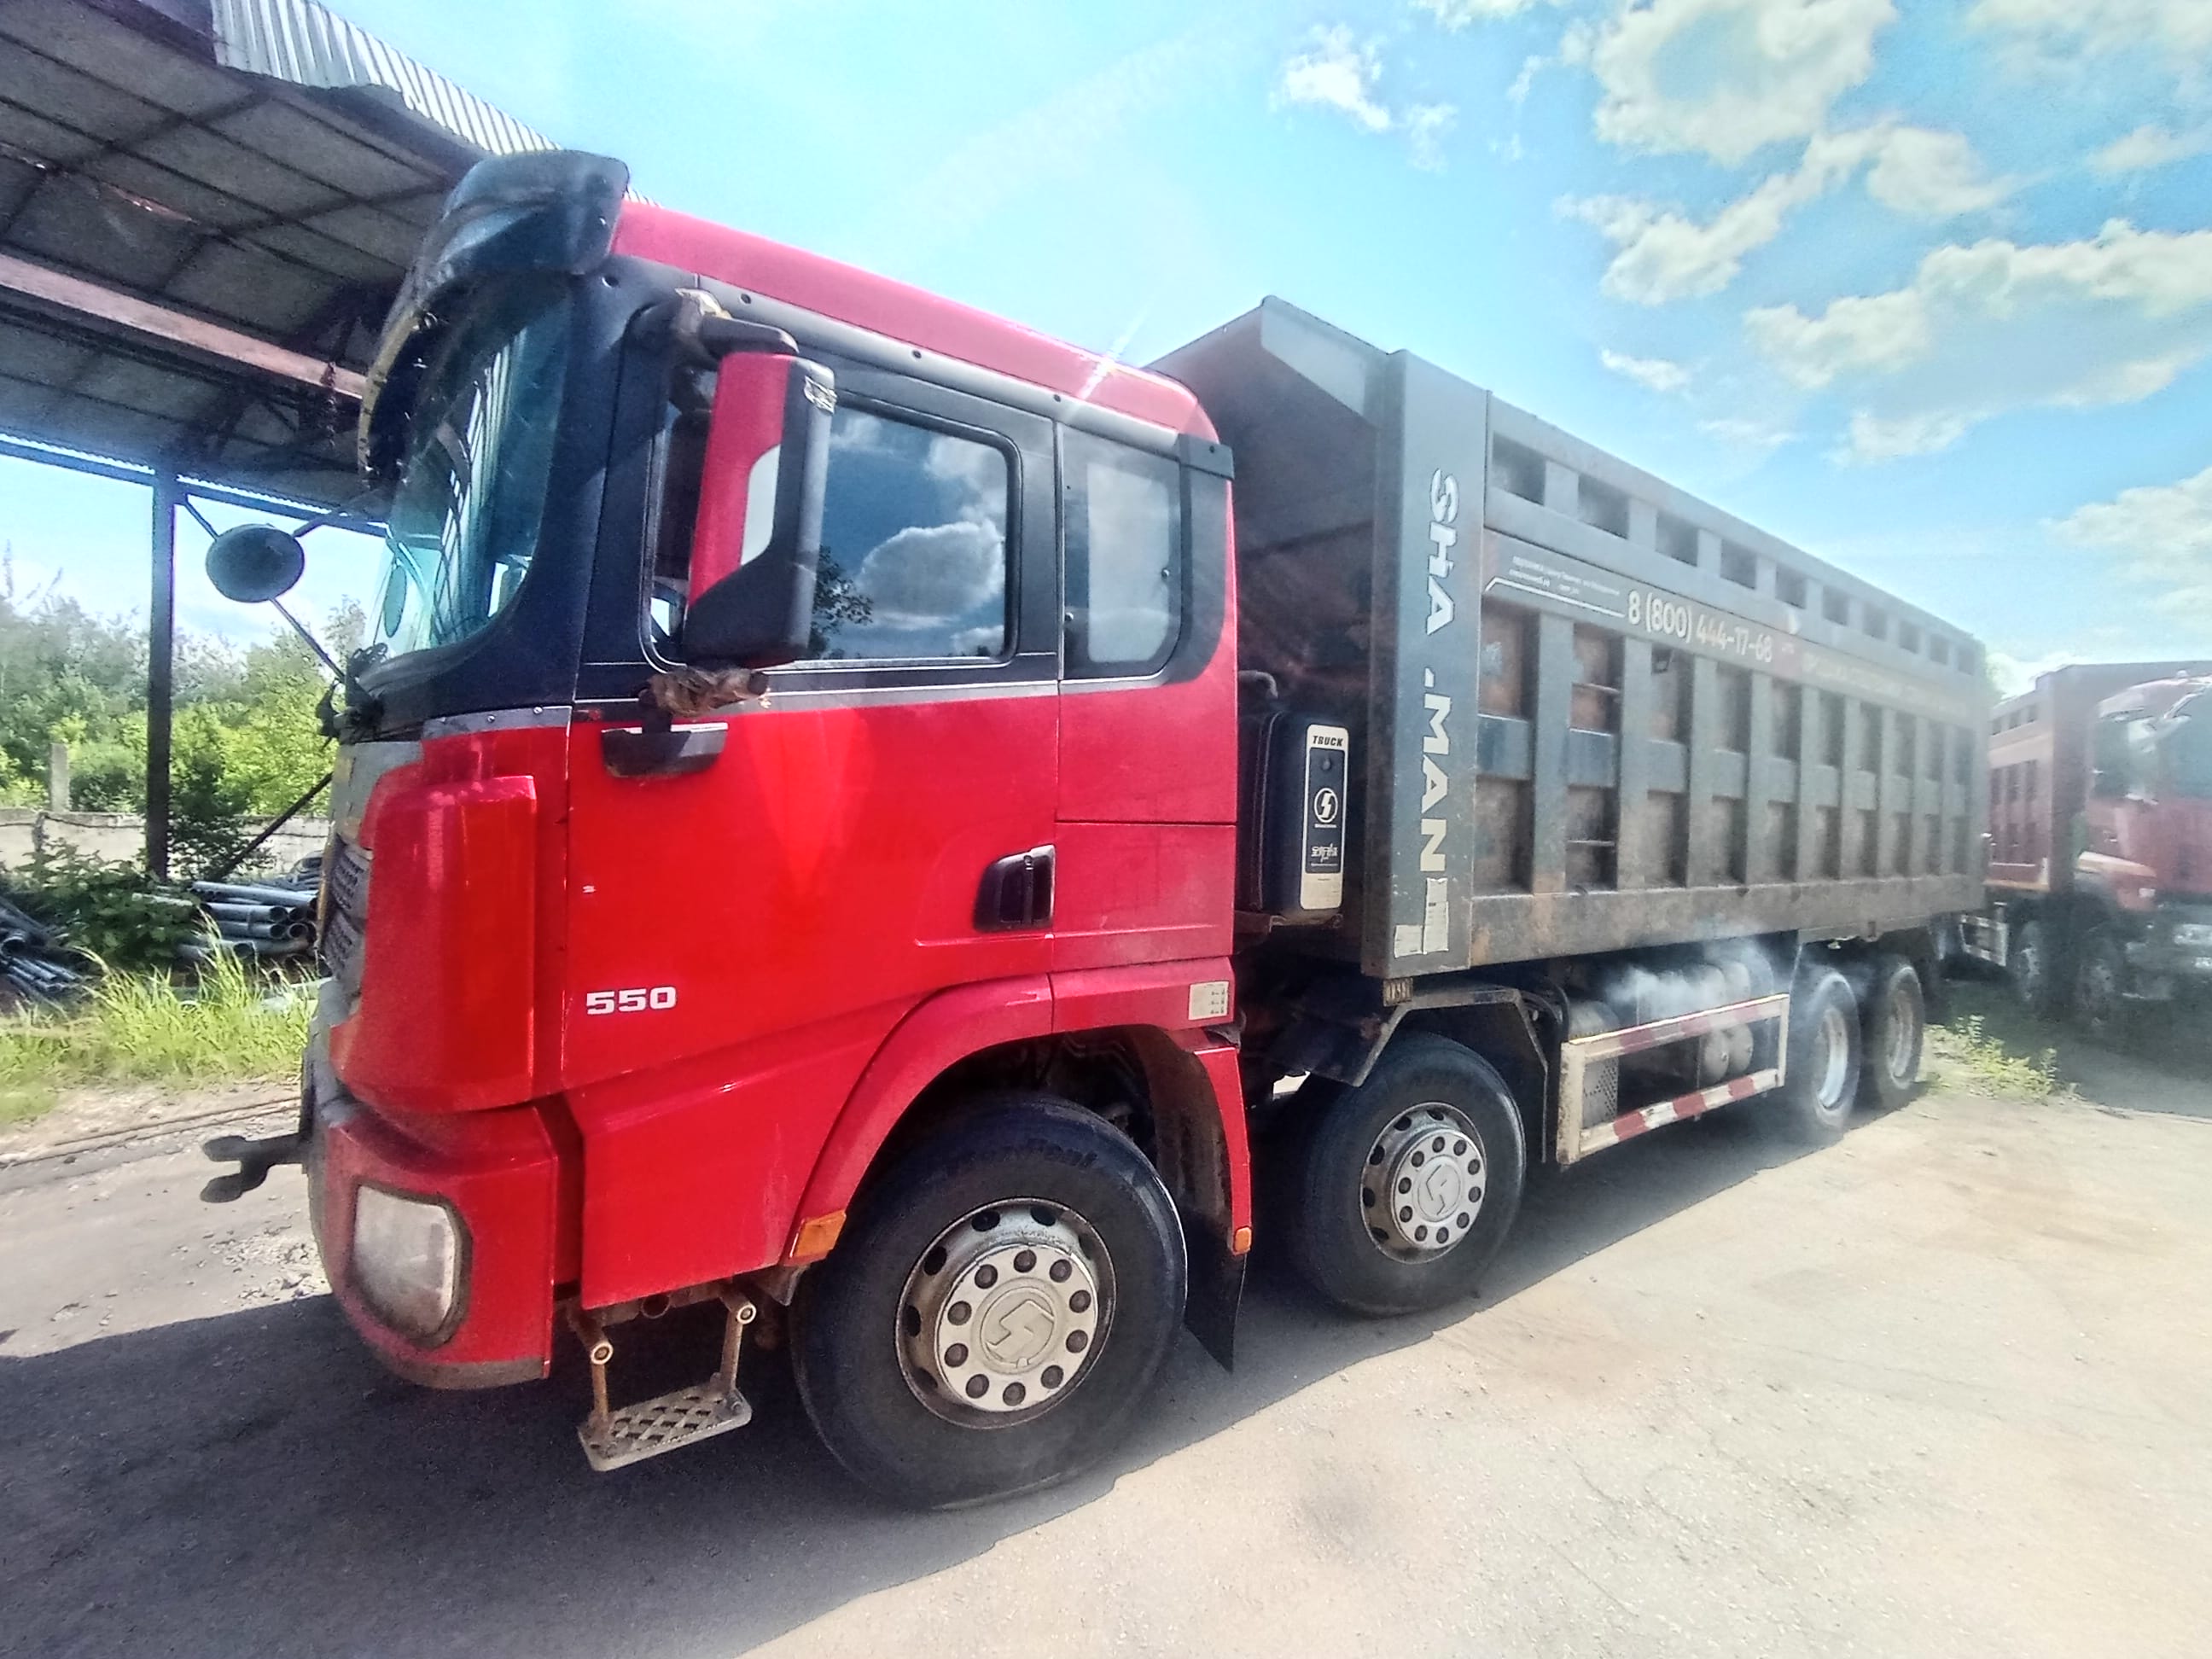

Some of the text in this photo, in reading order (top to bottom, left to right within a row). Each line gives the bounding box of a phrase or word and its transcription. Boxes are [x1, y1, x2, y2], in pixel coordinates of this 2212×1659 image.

[1628, 590, 1773, 663] 8 (800) 444-17-68
[1313, 736, 1344, 747] TRUCK
[586, 986, 677, 1015] 550
